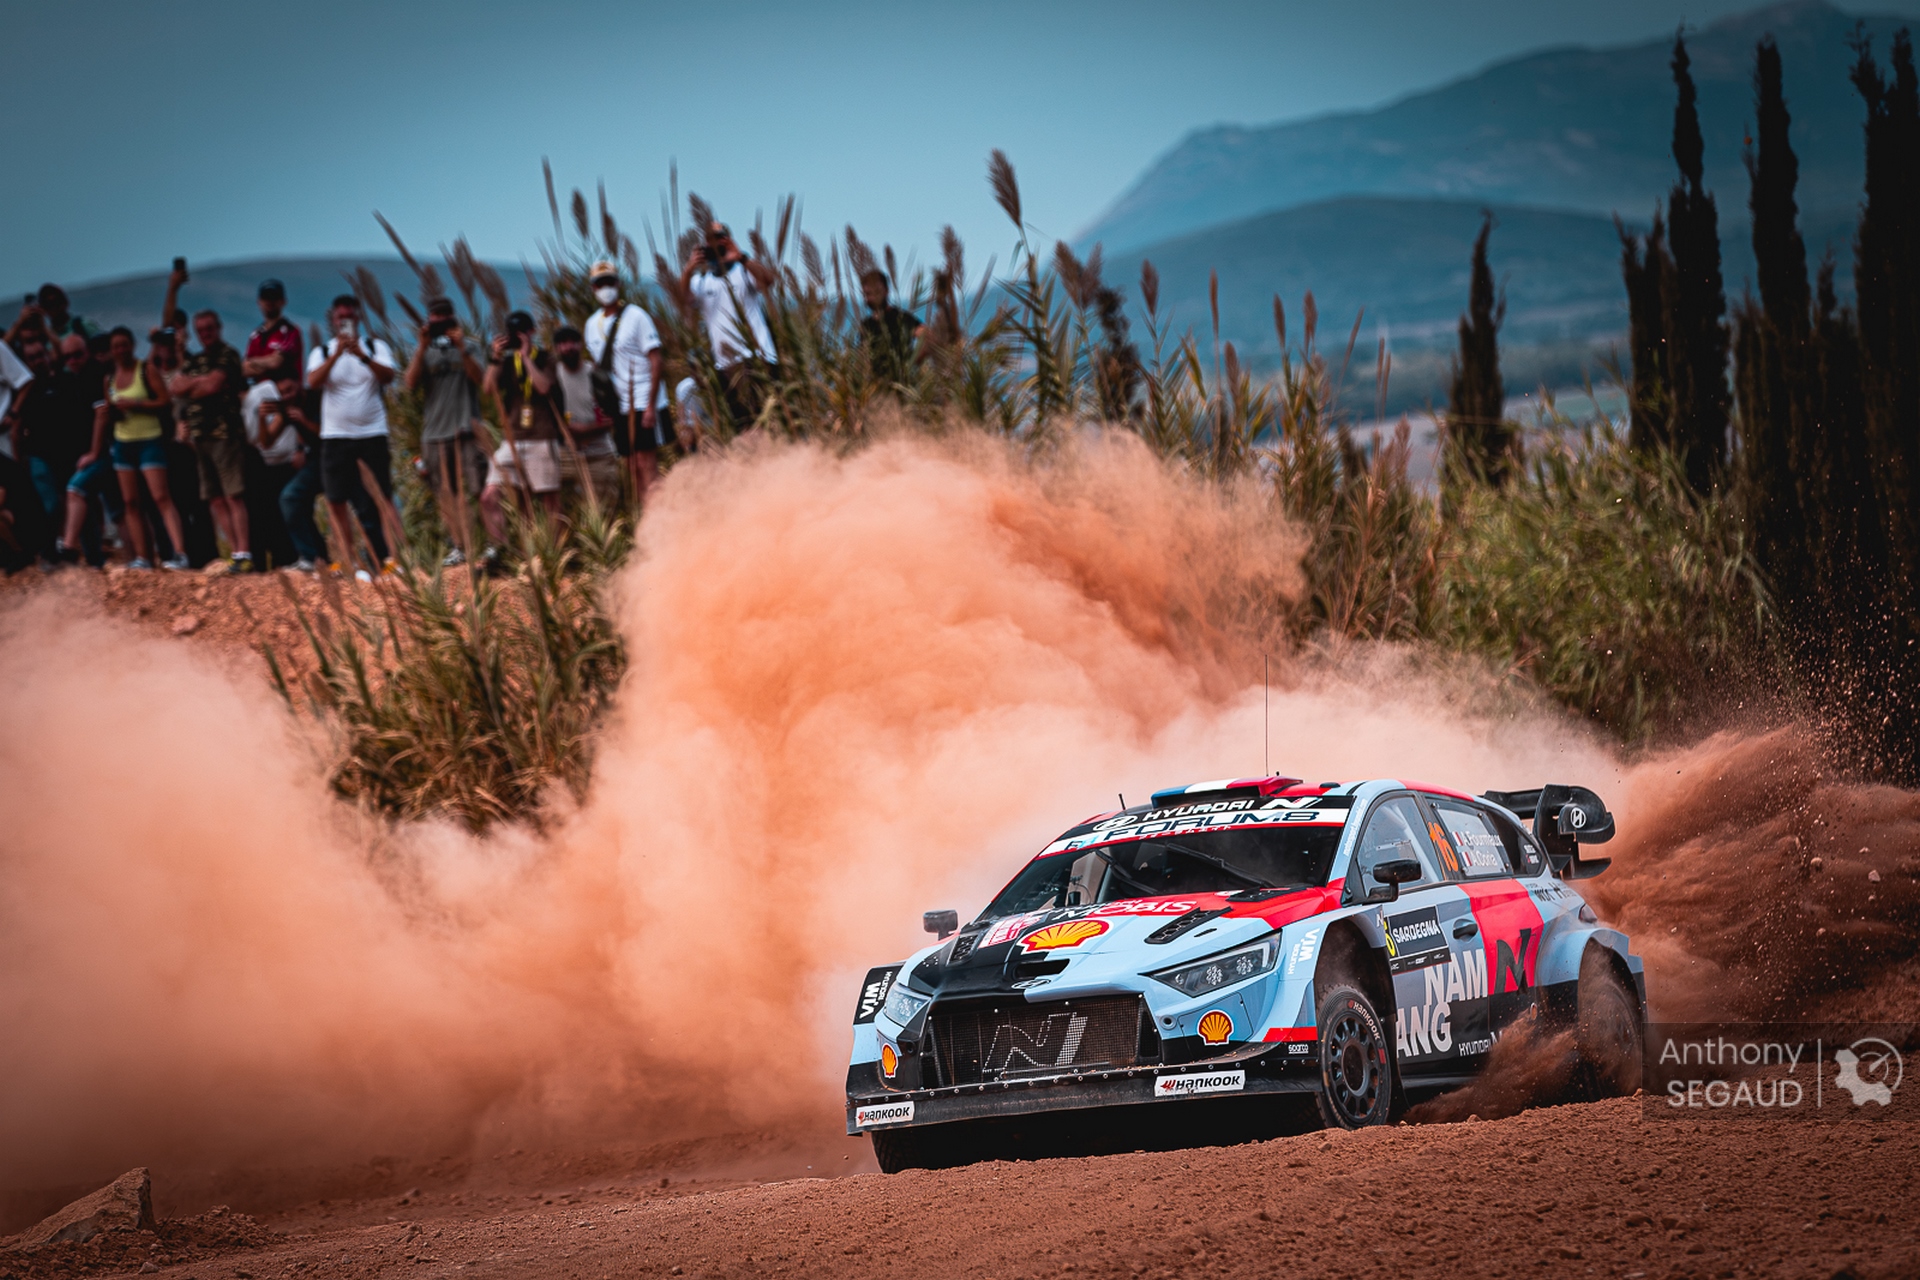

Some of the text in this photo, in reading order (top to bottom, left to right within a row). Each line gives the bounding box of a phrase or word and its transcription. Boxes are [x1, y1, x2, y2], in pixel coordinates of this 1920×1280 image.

[1142, 796, 1323, 822] HYUNDAI N
[1103, 811, 1320, 841] FORUM8
[1428, 821, 1459, 872] 16
[1052, 901, 1198, 921] MOBIS
[1392, 919, 1441, 944] SARDEGNA
[1287, 943, 1301, 975] HYUNDAI
[878, 971, 893, 1001] HYUNDAI
[1423, 948, 1489, 1007] NAM
[1396, 1002, 1453, 1059] ANG
[1458, 1039, 1493, 1057] HYUNDAI
